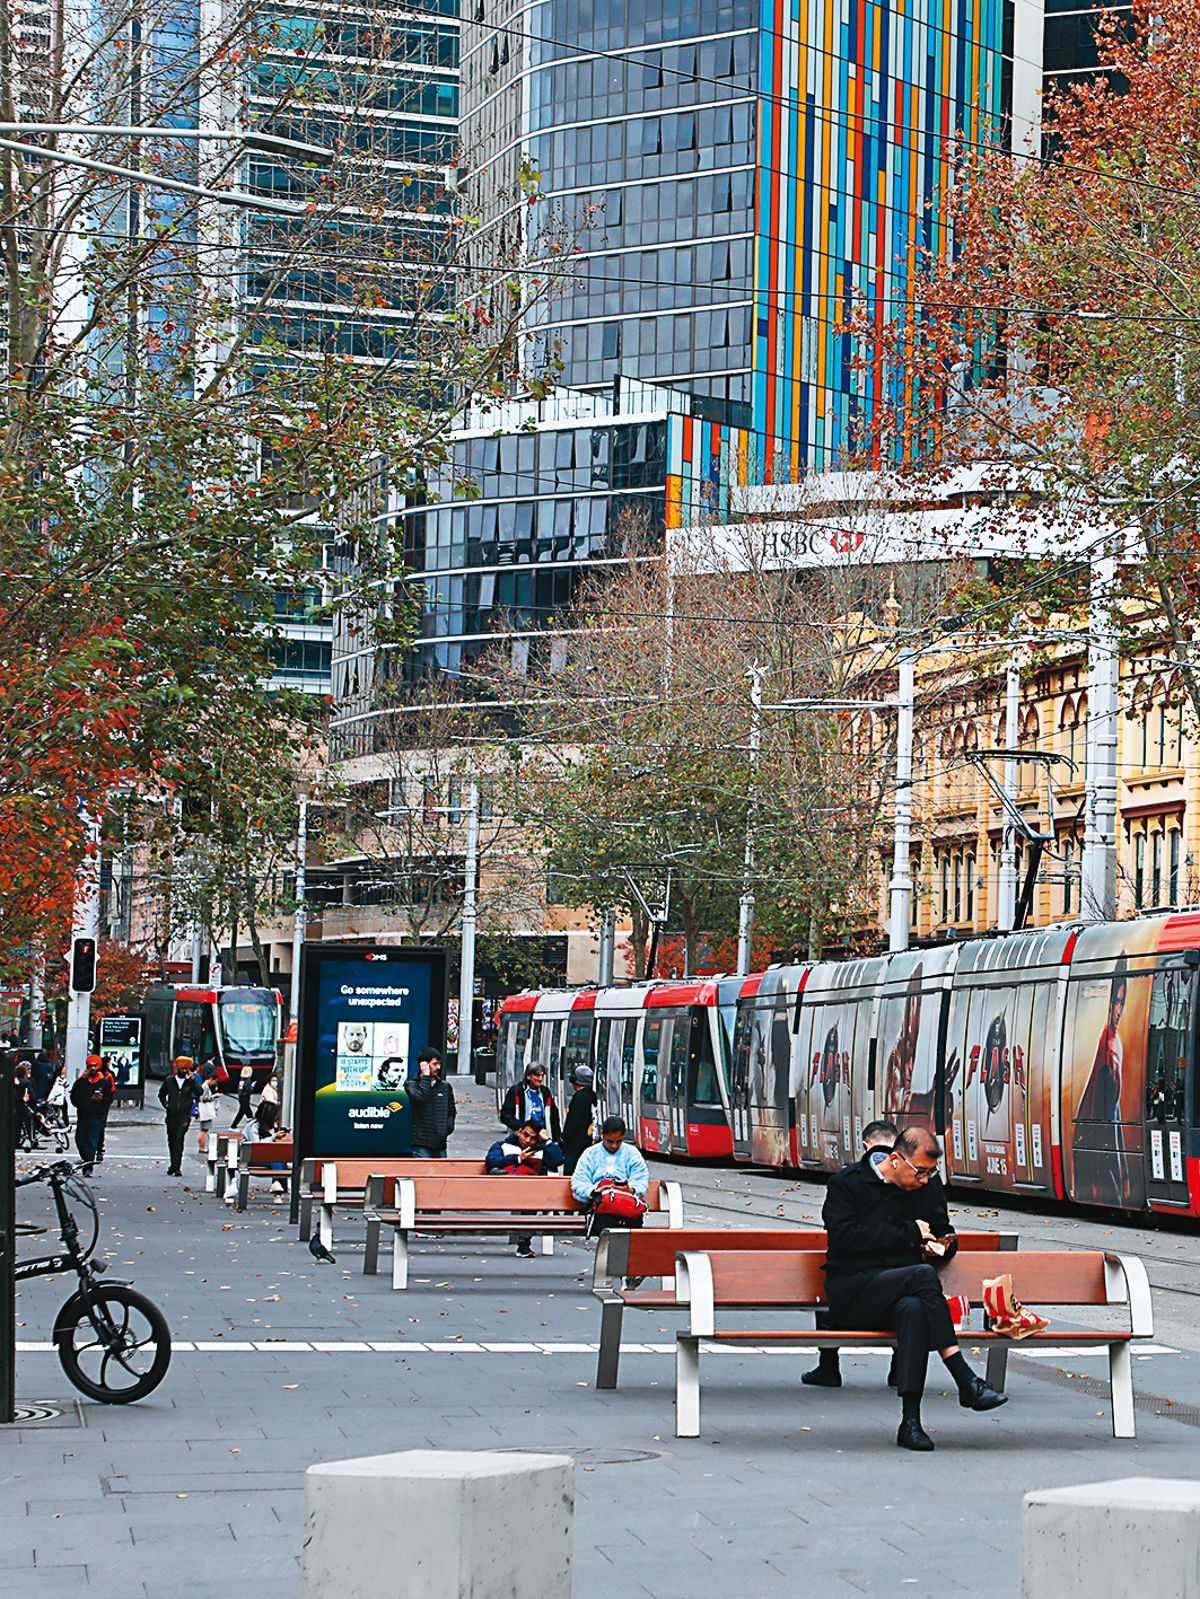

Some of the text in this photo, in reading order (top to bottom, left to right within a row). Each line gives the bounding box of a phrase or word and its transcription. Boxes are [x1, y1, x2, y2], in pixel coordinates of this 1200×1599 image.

[762, 531, 825, 557] HSBC
[341, 985, 410, 996] Go somewhere
[348, 997, 402, 1008] unexpected
[966, 1044, 1027, 1090] FLASH
[348, 1107, 391, 1118] audible
